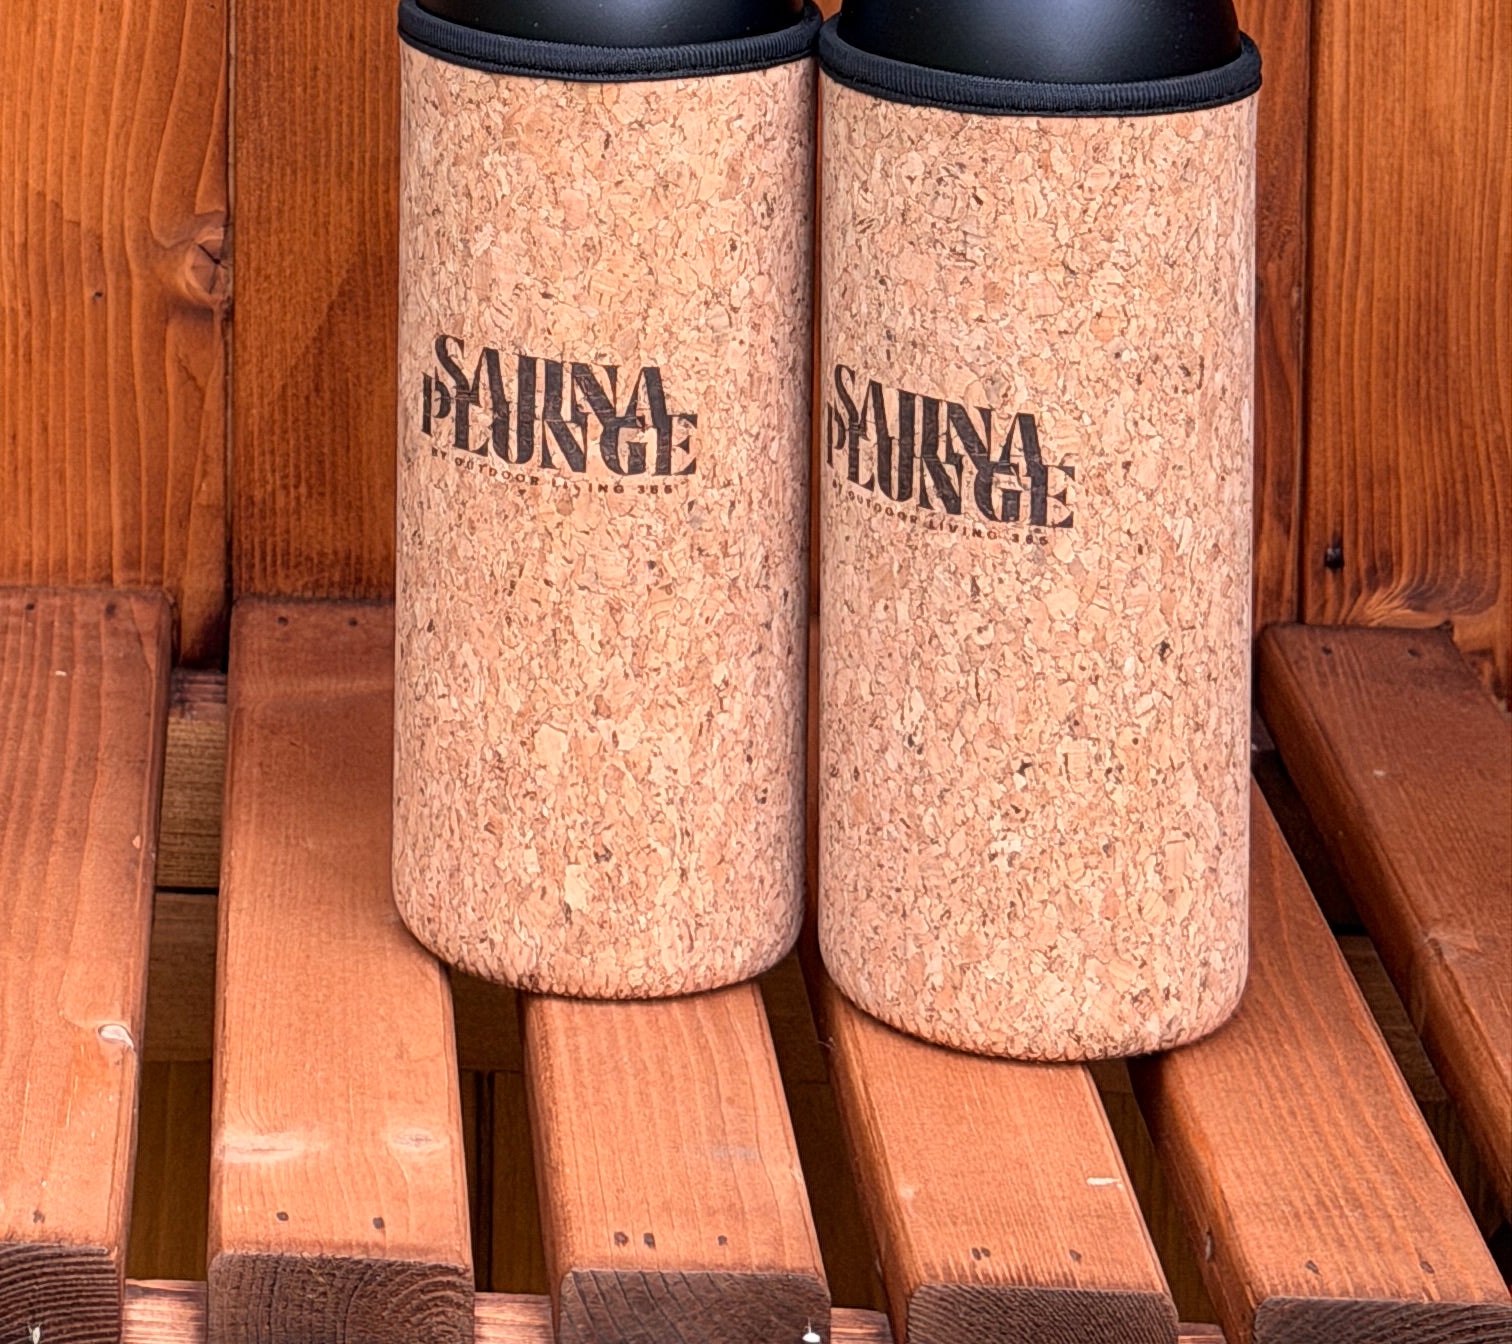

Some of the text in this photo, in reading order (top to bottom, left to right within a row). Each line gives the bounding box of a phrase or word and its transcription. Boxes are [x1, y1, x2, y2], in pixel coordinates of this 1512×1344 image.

[421, 368, 698, 477] PLUNGE
[434, 333, 674, 432] SAUNA
[834, 363, 1044, 469] SAUNA
[454, 456, 540, 486] OUTDOOR
[826, 401, 1075, 529] PLUNGE
[848, 490, 918, 525] OUTDOOR
[928, 518, 998, 541] LIVING
